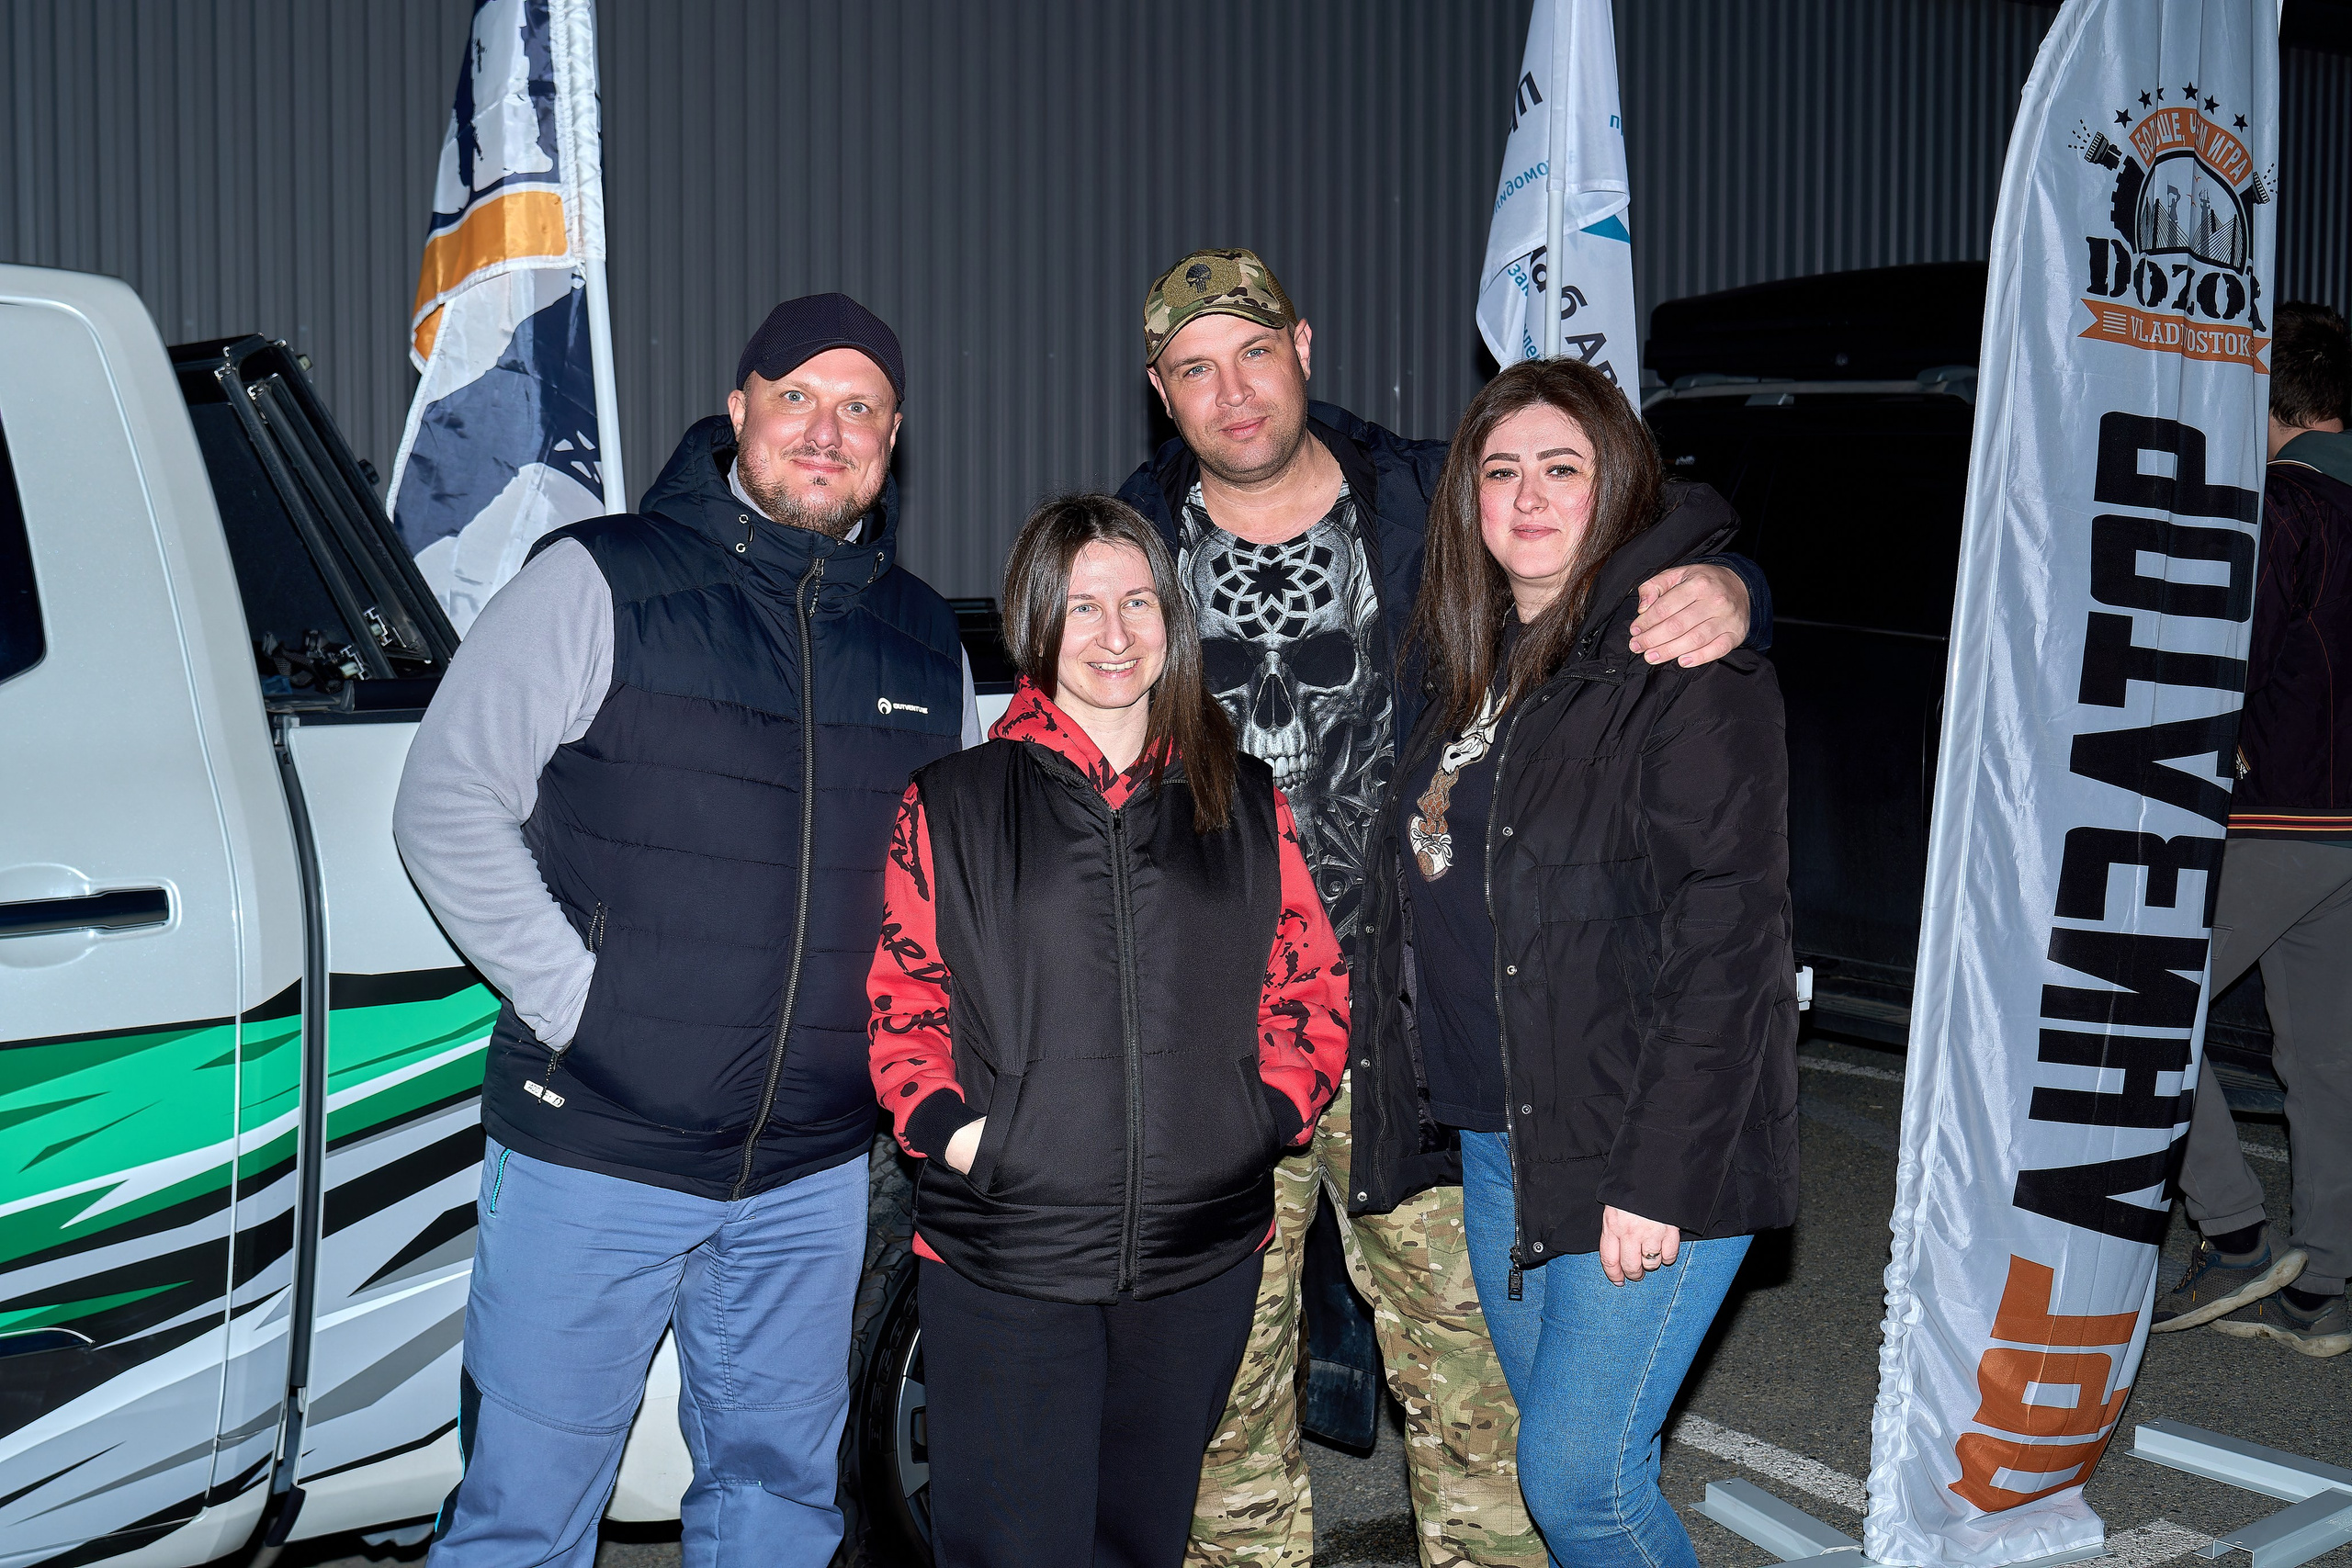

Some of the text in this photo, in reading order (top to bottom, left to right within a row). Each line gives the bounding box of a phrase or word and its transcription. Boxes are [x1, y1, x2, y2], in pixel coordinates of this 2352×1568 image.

[2189, 113, 2209, 153] ЧЕМ
[2206, 132, 2248, 181] ИГРА
[2086, 236, 2267, 332] DOZOR
[2131, 315, 2254, 358] VLADIVOSTOK
